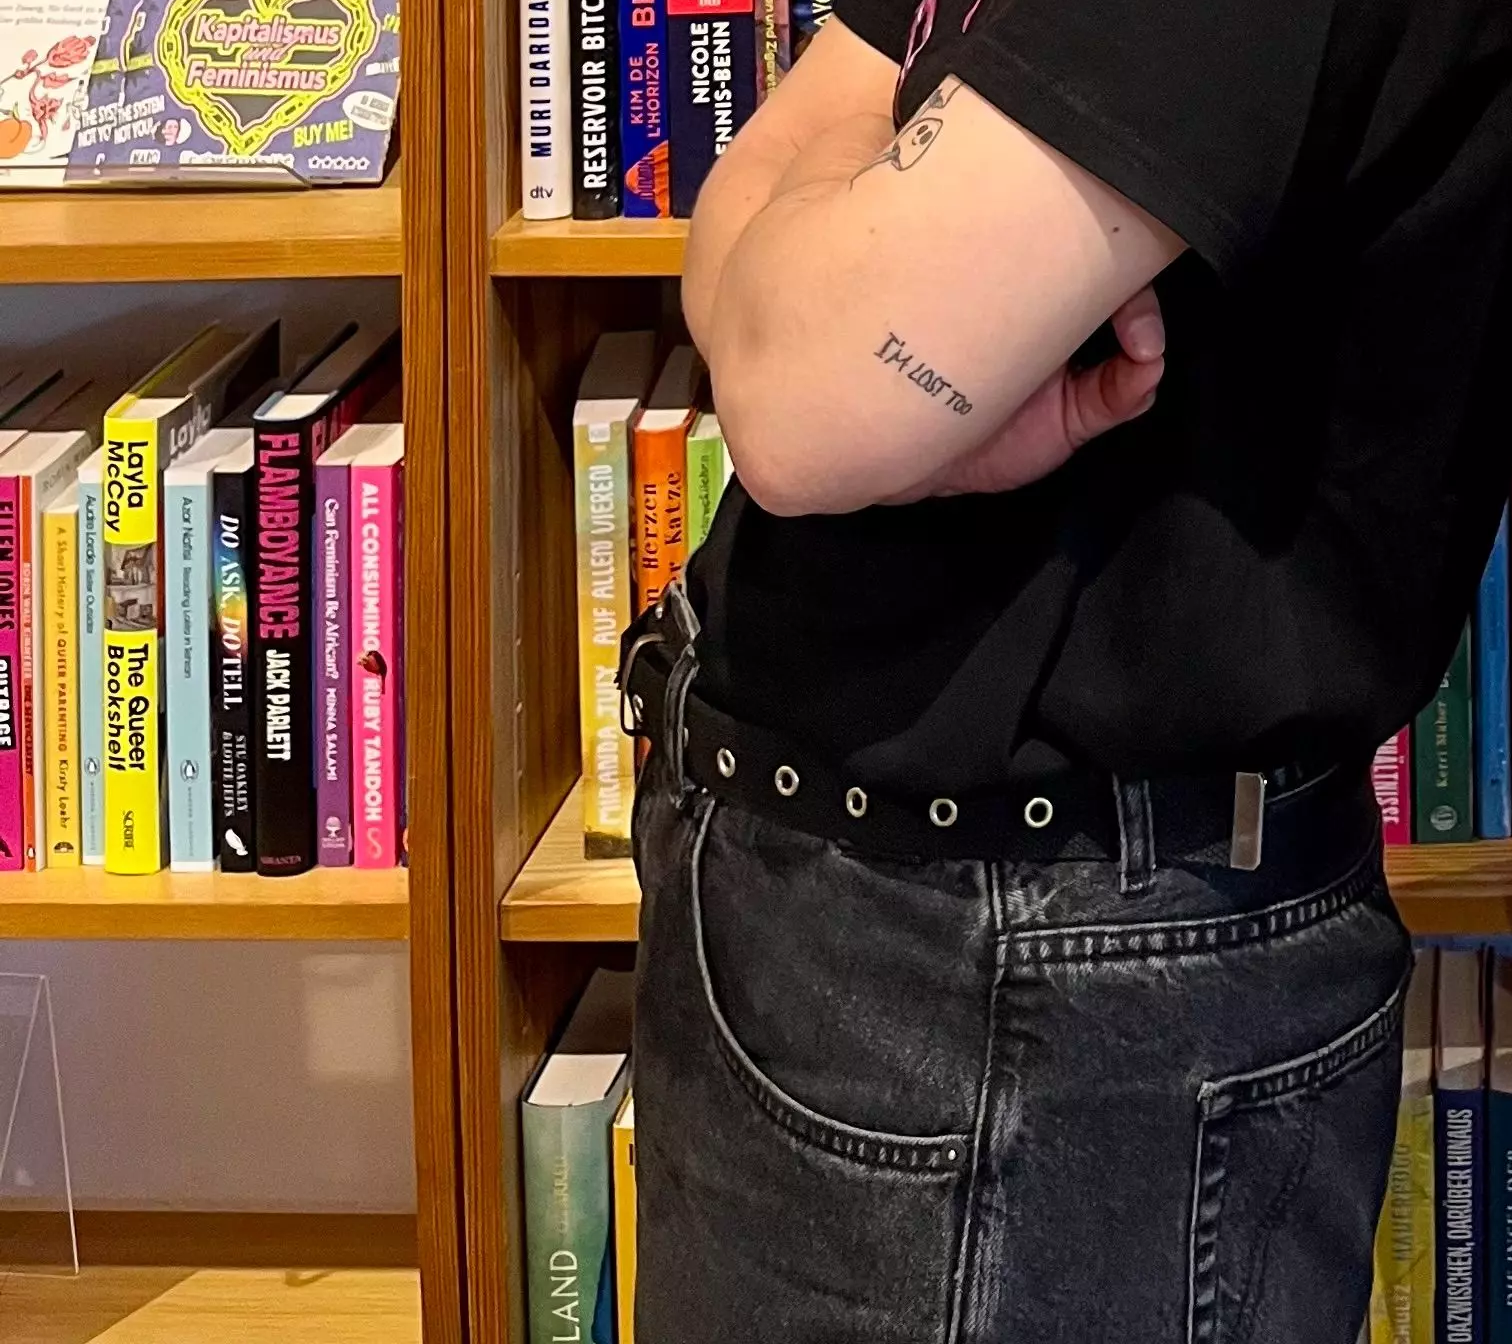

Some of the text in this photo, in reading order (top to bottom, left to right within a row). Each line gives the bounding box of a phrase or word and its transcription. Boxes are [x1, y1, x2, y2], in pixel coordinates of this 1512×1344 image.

[198, 15, 342, 46] Kapitalismus
[692, 22, 710, 104] NICOLE
[186, 64, 327, 90] Feminismus
[629, 55, 645, 125] KIM DE
[294, 120, 353, 147] BUY ME!
[583, 61, 608, 190] RESERVOIR
[909, 361, 948, 401] LOST
[945, 386, 974, 416] TOO
[106, 440, 124, 533] McCay
[127, 440, 150, 510] Layla
[664, 470, 682, 543] Katze
[217, 514, 241, 548] DO
[258, 433, 300, 641] FLAMBOYANCE
[590, 464, 616, 646] AUF ALLEN VIEREN
[220, 616, 244, 650] DO
[107, 645, 128, 773] Bookshelf
[127, 643, 148, 773] The Queer
[222, 652, 244, 711] TELL
[266, 649, 293, 761] JACK PARLETT
[1442, 1108, 1473, 1343] DAZWISCHEN, DARÜBER HINAUS
